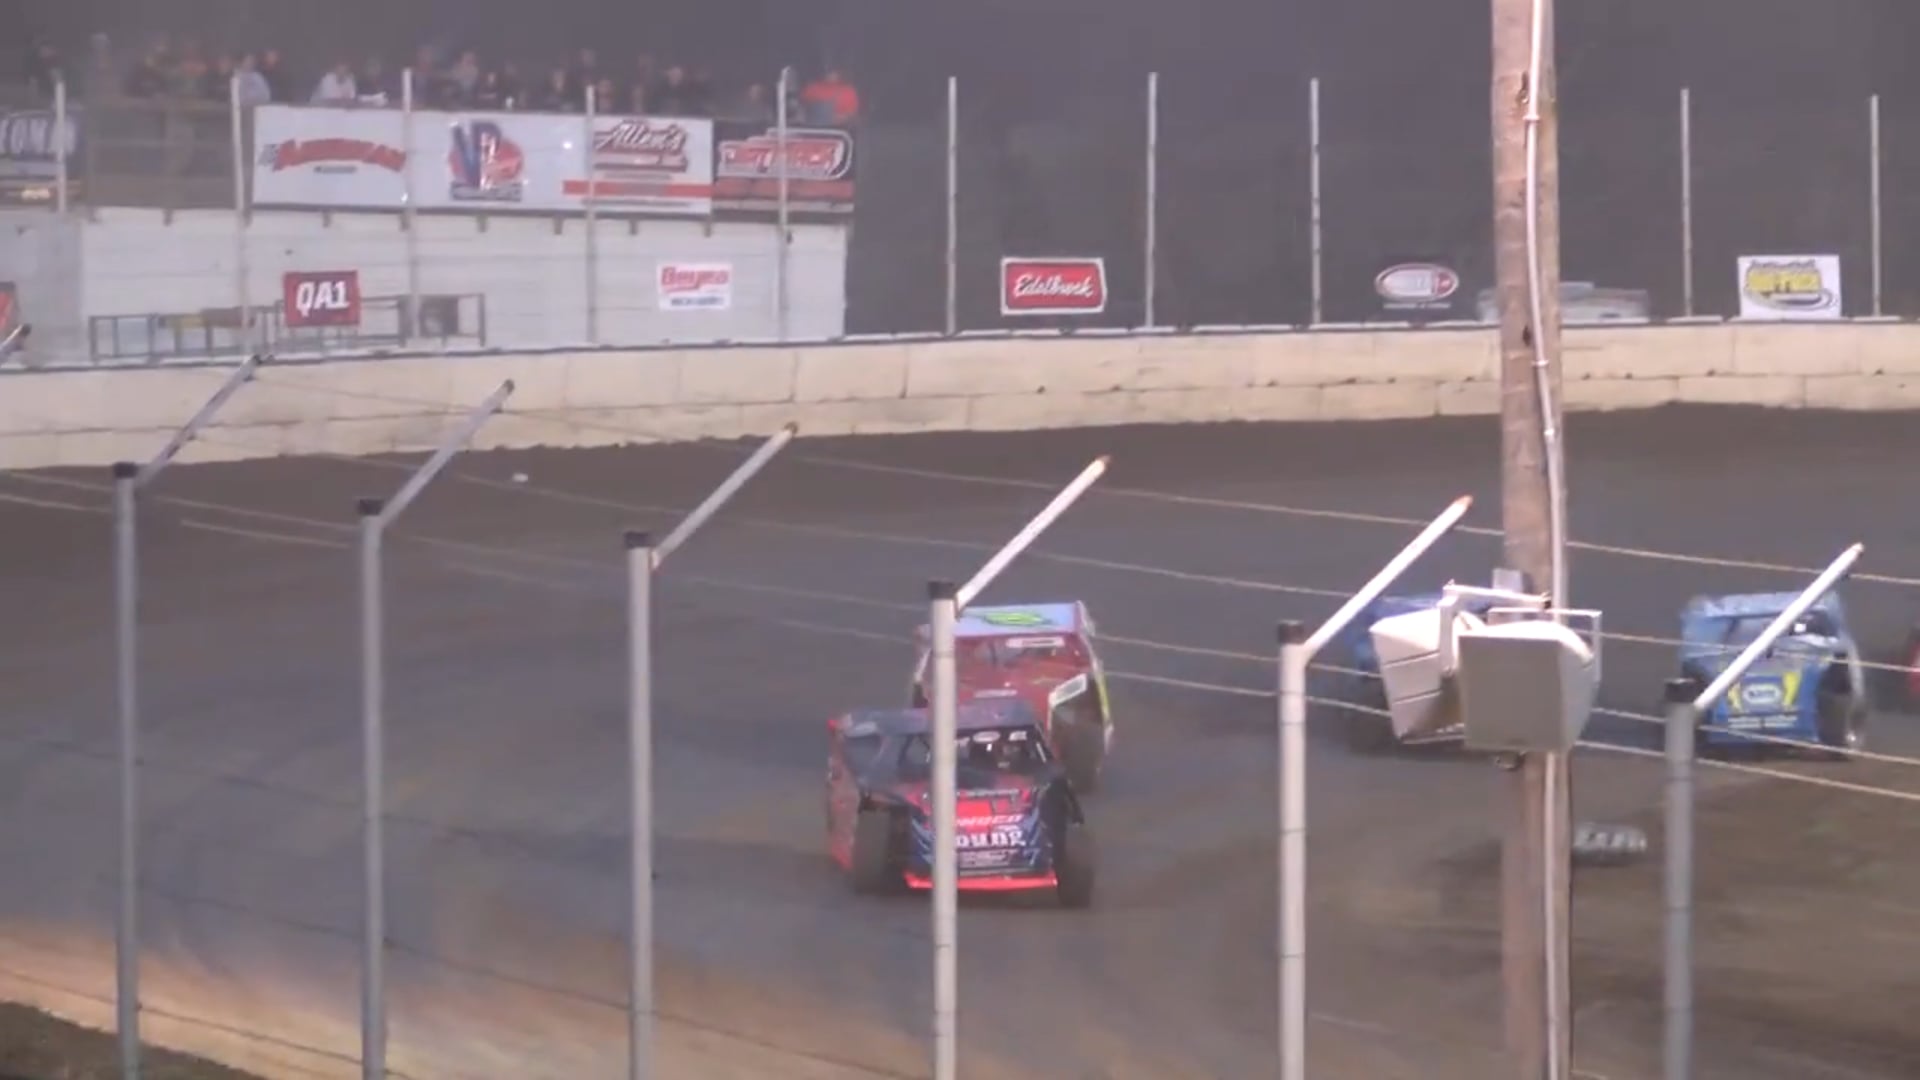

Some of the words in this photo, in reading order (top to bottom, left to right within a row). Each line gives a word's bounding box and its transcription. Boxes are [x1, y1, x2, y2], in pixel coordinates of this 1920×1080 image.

[296, 280, 351, 318] QA1
[1013, 273, 1094, 299] Edelbrock
[957, 831, 1026, 849] oung
